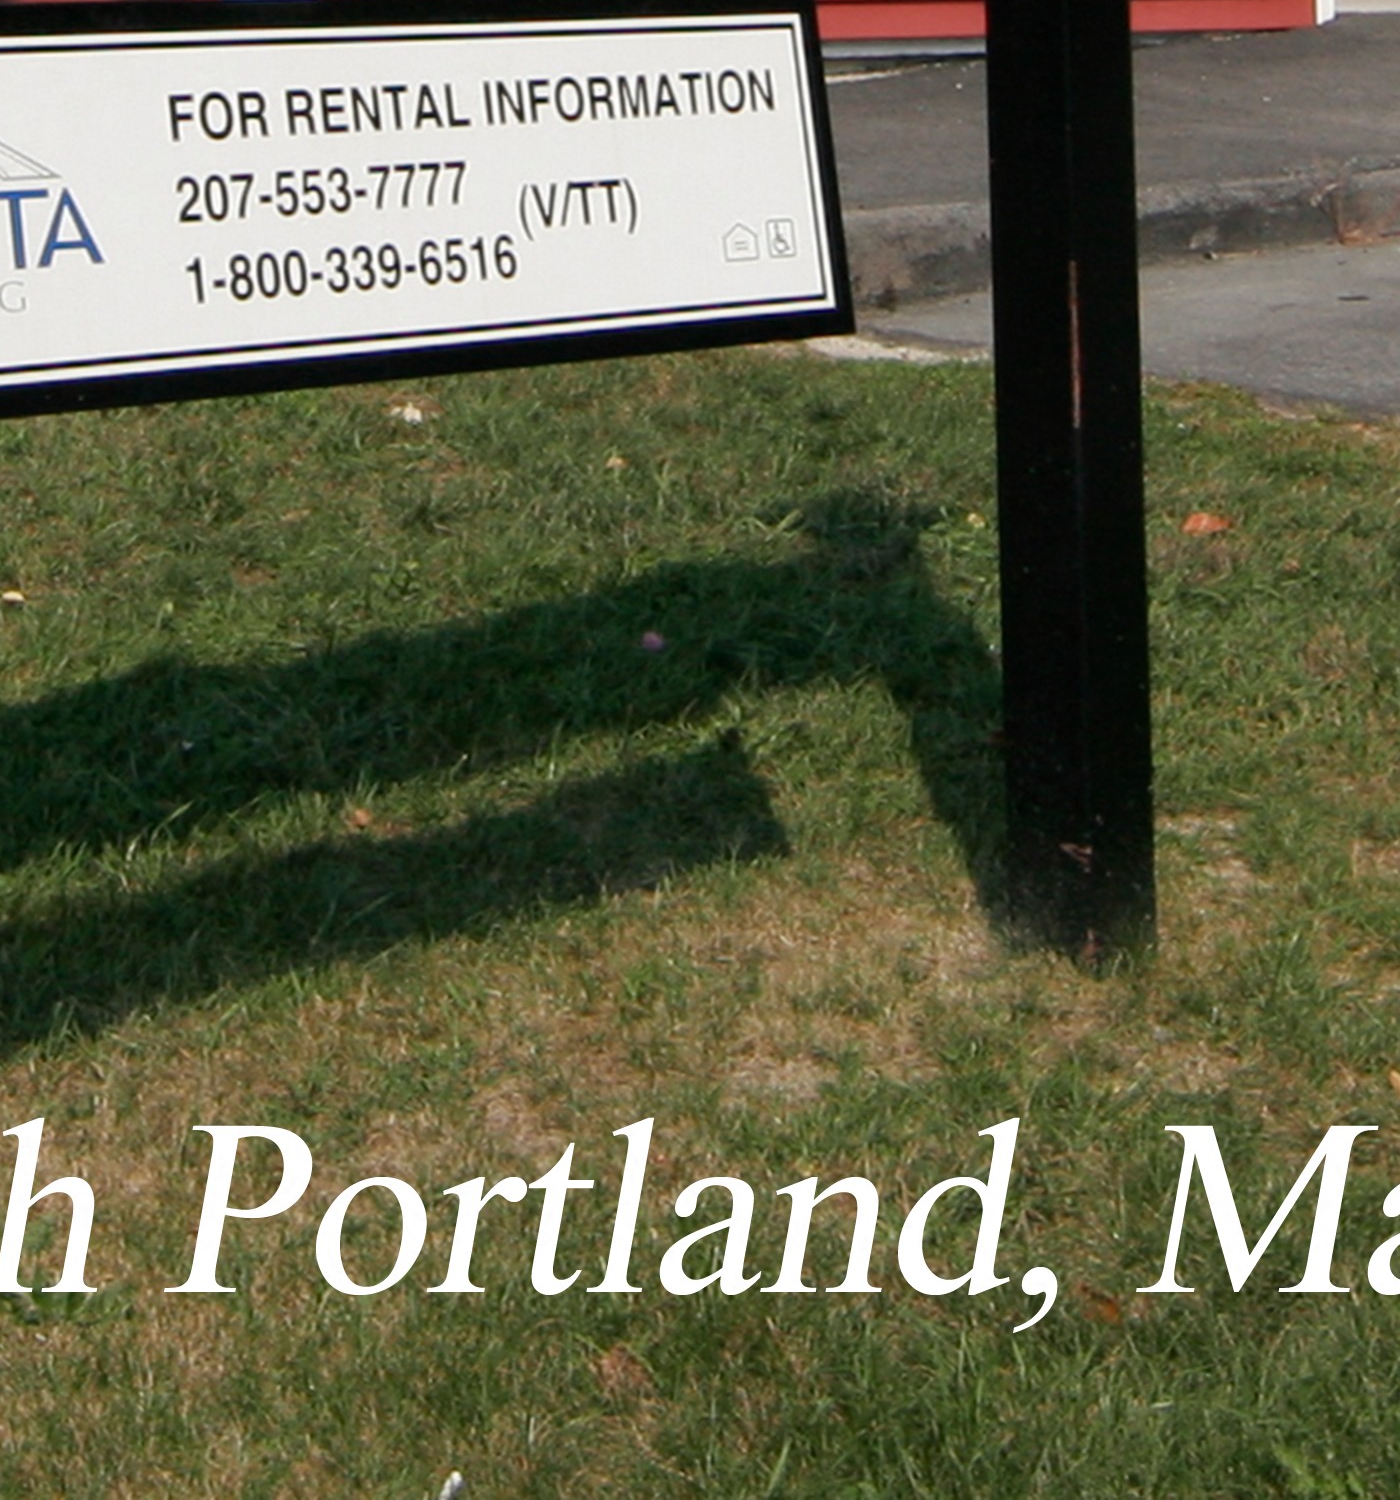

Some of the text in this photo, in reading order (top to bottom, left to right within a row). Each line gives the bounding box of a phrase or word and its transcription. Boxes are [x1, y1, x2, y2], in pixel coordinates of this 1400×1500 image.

[167, 69, 775, 140] FOR RENTAL INFORMATION
[176, 160, 467, 223] 207-553-7777
[519, 177, 641, 239] (V/TT)
[185, 234, 519, 304] 1-800-339-6516
